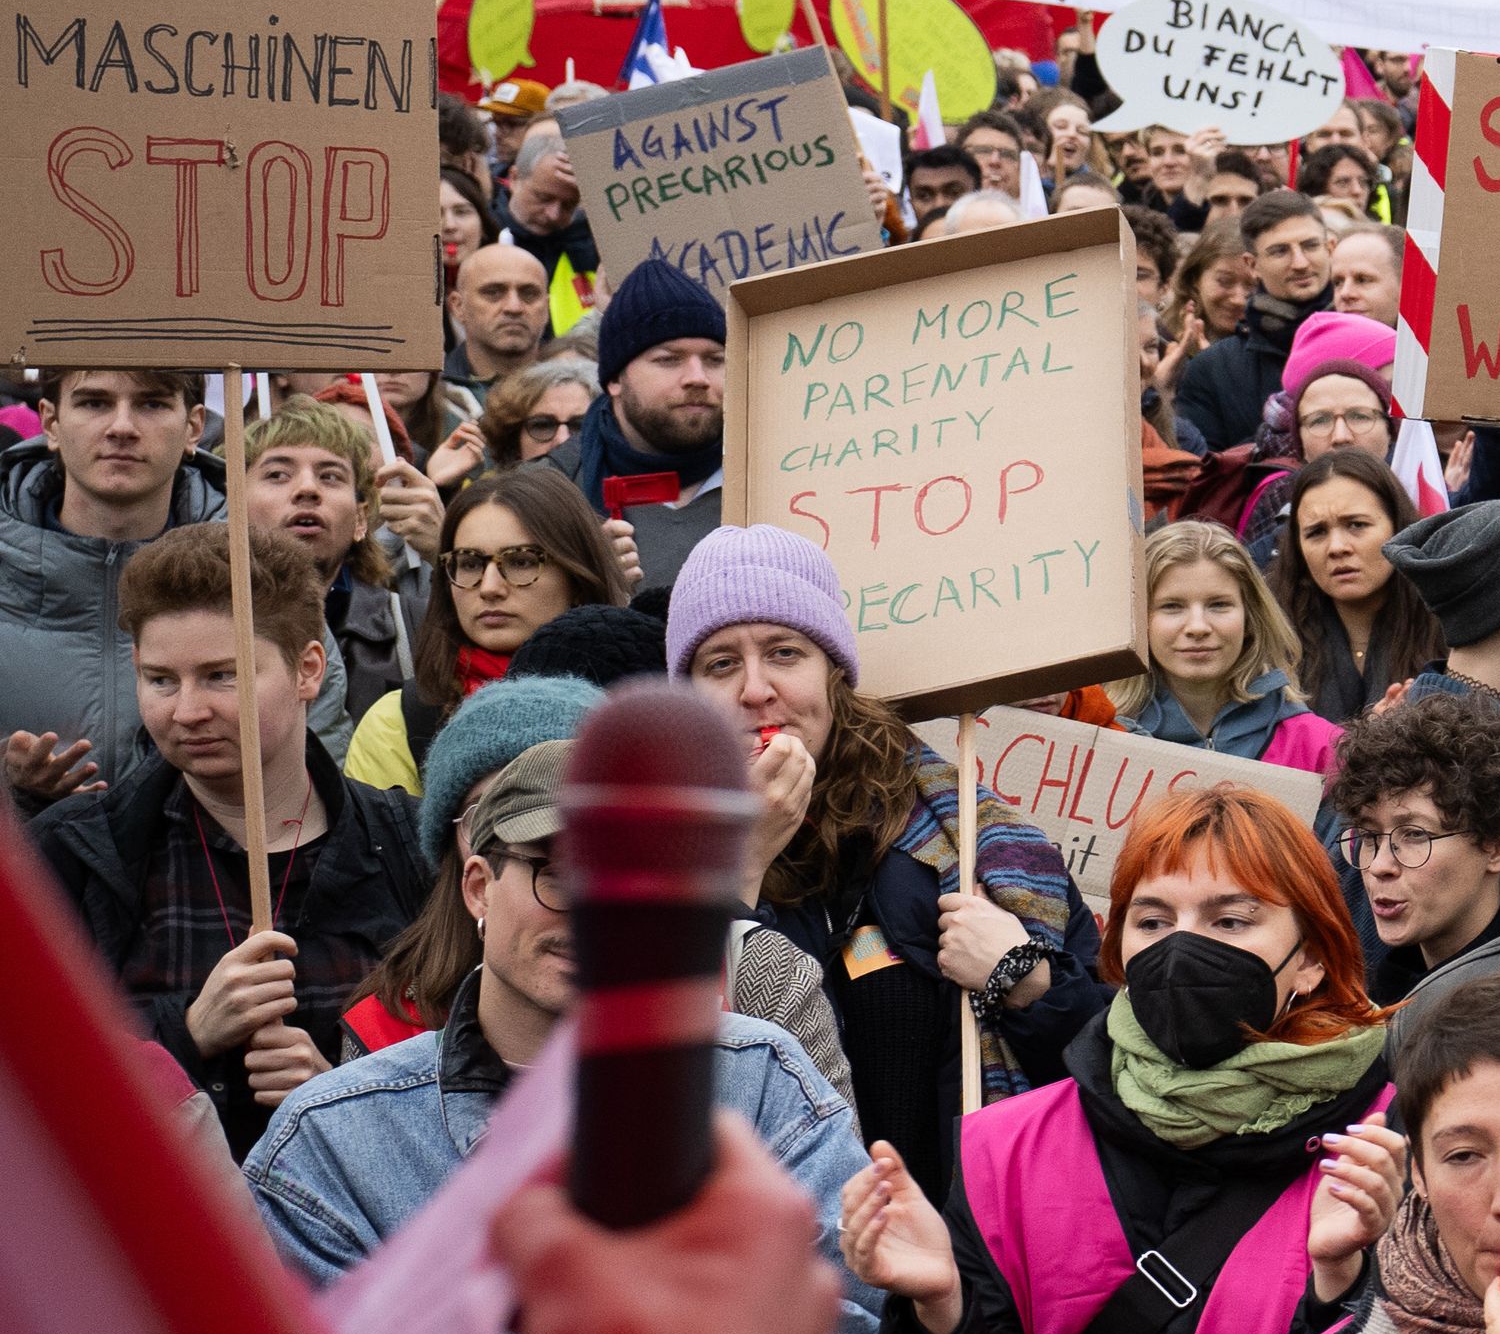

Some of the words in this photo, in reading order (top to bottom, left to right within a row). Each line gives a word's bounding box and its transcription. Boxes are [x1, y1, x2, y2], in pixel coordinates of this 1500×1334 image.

[1124, 29, 1174, 57] DU
[1204, 44, 1339, 96] FEHLST
[1163, 74, 1263, 117] UNS!
[612, 95, 789, 171] AGAINST
[41, 126, 391, 307] STOP
[604, 134, 835, 221] PRECARIOUS
[648, 211, 862, 289] ACADEMIC
[782, 321, 865, 374] NO
[912, 273, 1080, 345] MORE
[803, 343, 1074, 421] PARENTAL
[780, 407, 994, 473] CHARITY
[789, 459, 1045, 551] STOP
